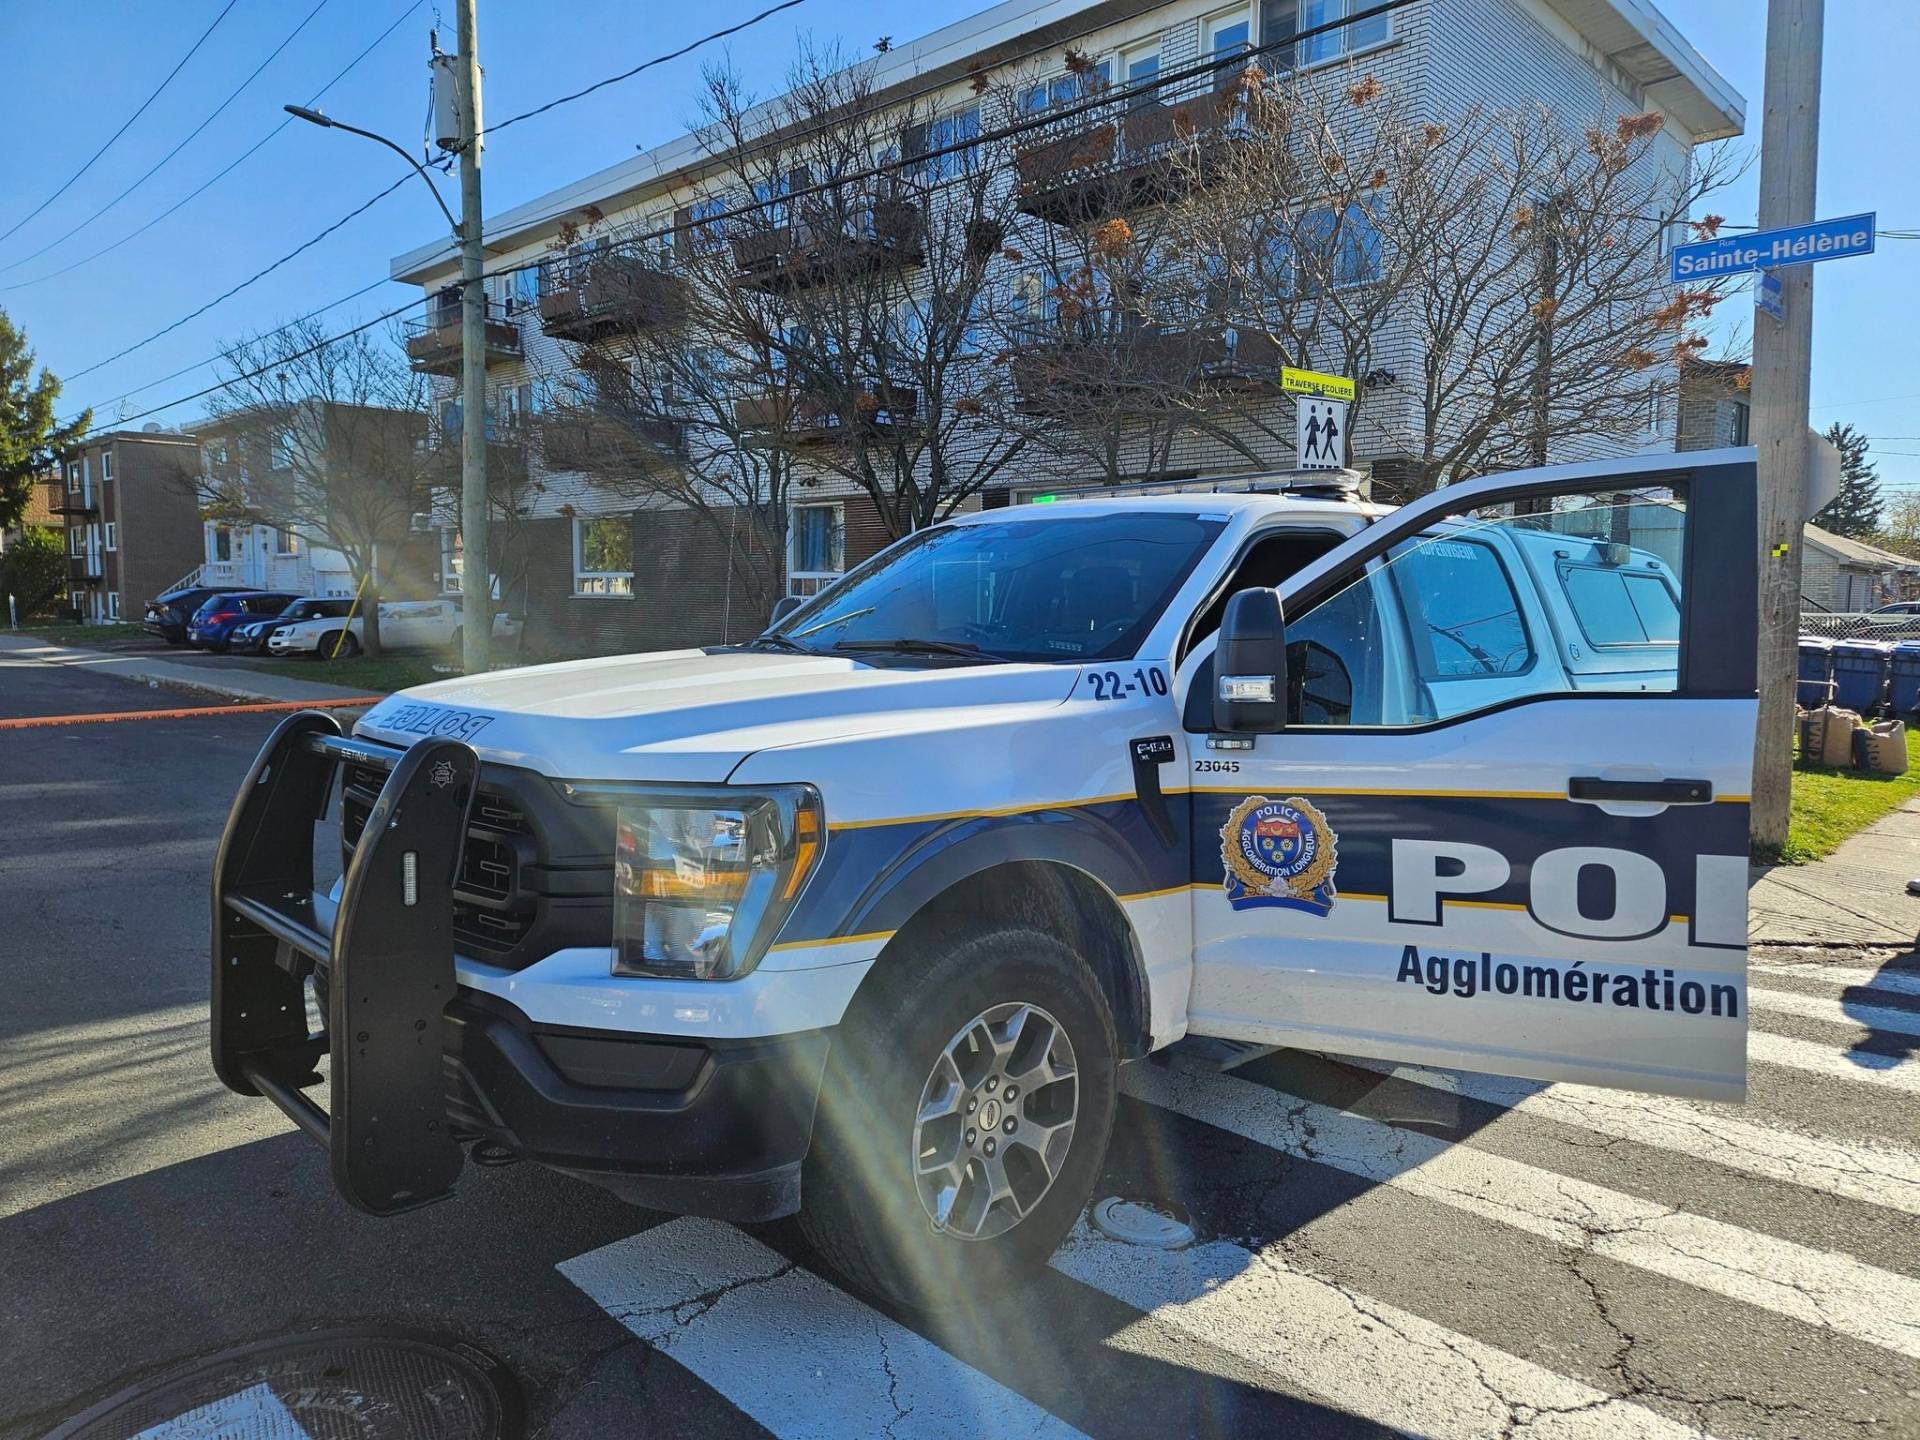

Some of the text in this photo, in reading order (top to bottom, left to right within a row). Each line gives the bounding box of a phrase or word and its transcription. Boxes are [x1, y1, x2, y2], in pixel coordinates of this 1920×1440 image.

[1678, 231, 1868, 275] Sainte-Hélène
[1719, 239, 1737, 248] Rue
[1286, 378, 1319, 391] TRAVERSE
[1087, 667, 1168, 701] 22-10
[1194, 760, 1240, 773] 23045
[1256, 805, 1301, 822] POLICE
[1241, 828, 1316, 876] AGGLOMÉRATION LONGUEUIL
[1396, 944, 1738, 1018] Agglomération
